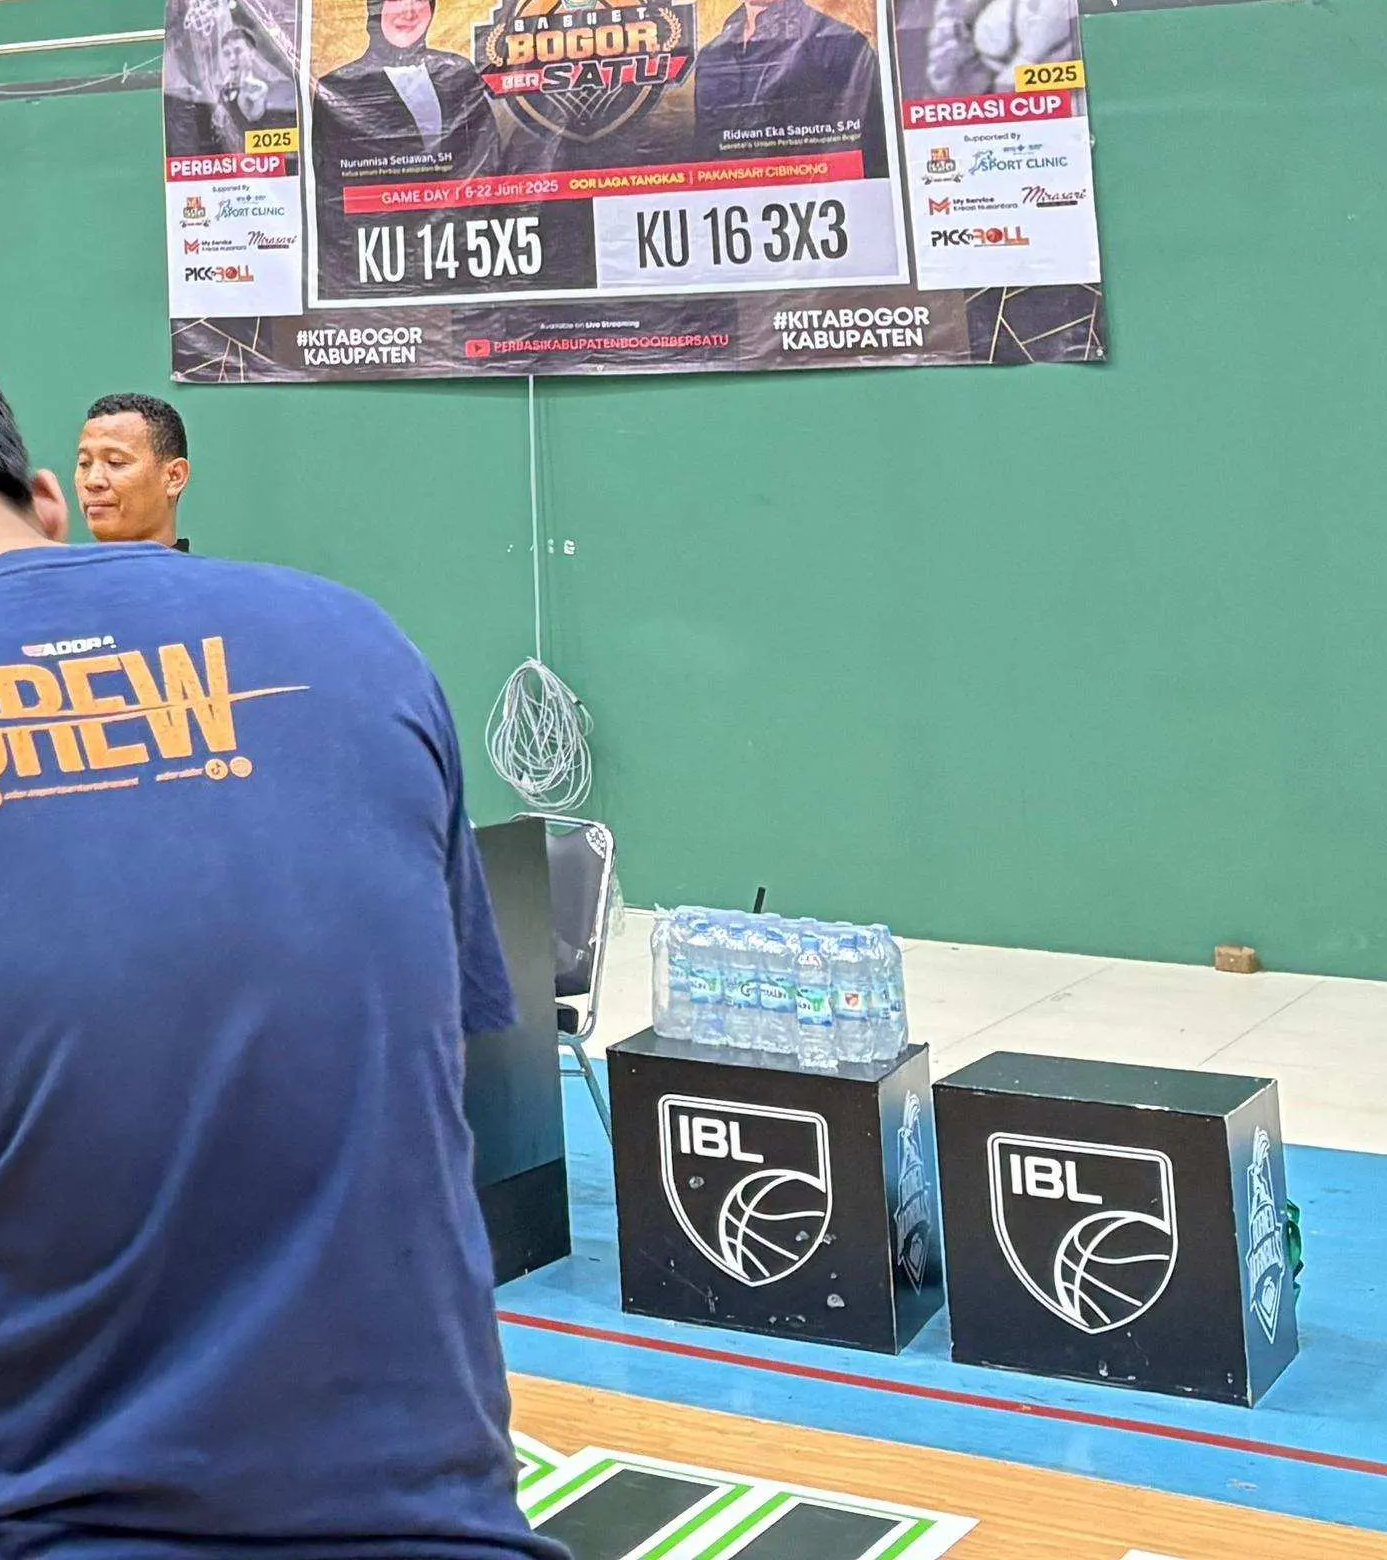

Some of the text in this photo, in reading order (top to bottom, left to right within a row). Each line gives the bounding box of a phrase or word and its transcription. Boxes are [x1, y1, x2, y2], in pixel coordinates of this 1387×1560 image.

[506, 20, 660, 66] BOGOR
[502, 53, 671, 93] BER SATU
[1024, 65, 1077, 85] 2025
[910, 95, 1063, 124] PERBASI CUP
[252, 132, 291, 148] 2025
[723, 118, 861, 141] Ridwan Eka Saputra, S.Pd
[171, 156, 280, 176] PERBASI CUP
[340, 151, 452, 169] Nurunnisa Setiawan, SH
[1026, 156, 1068, 169] CLINIC
[569, 162, 829, 190] GOR LAGA TANGKAS PAKANSARI CIBINONG
[381, 191, 421, 205] GAME
[424, 189, 450, 202] DAY
[525, 179, 559, 194] 2025
[251, 206, 286, 216] CLINIC
[637, 199, 849, 268] KU 16 3X3
[358, 216, 542, 283] KU 14 5X5
[772, 306, 930, 331] #KITABOGOR
[296, 326, 422, 347] #KITABOGOR
[781, 327, 924, 350] KABUPATEN
[304, 345, 416, 365] KABUPATEN
[679, 1114, 764, 1165] IBL
[1010, 1154, 1103, 1205] IBL
